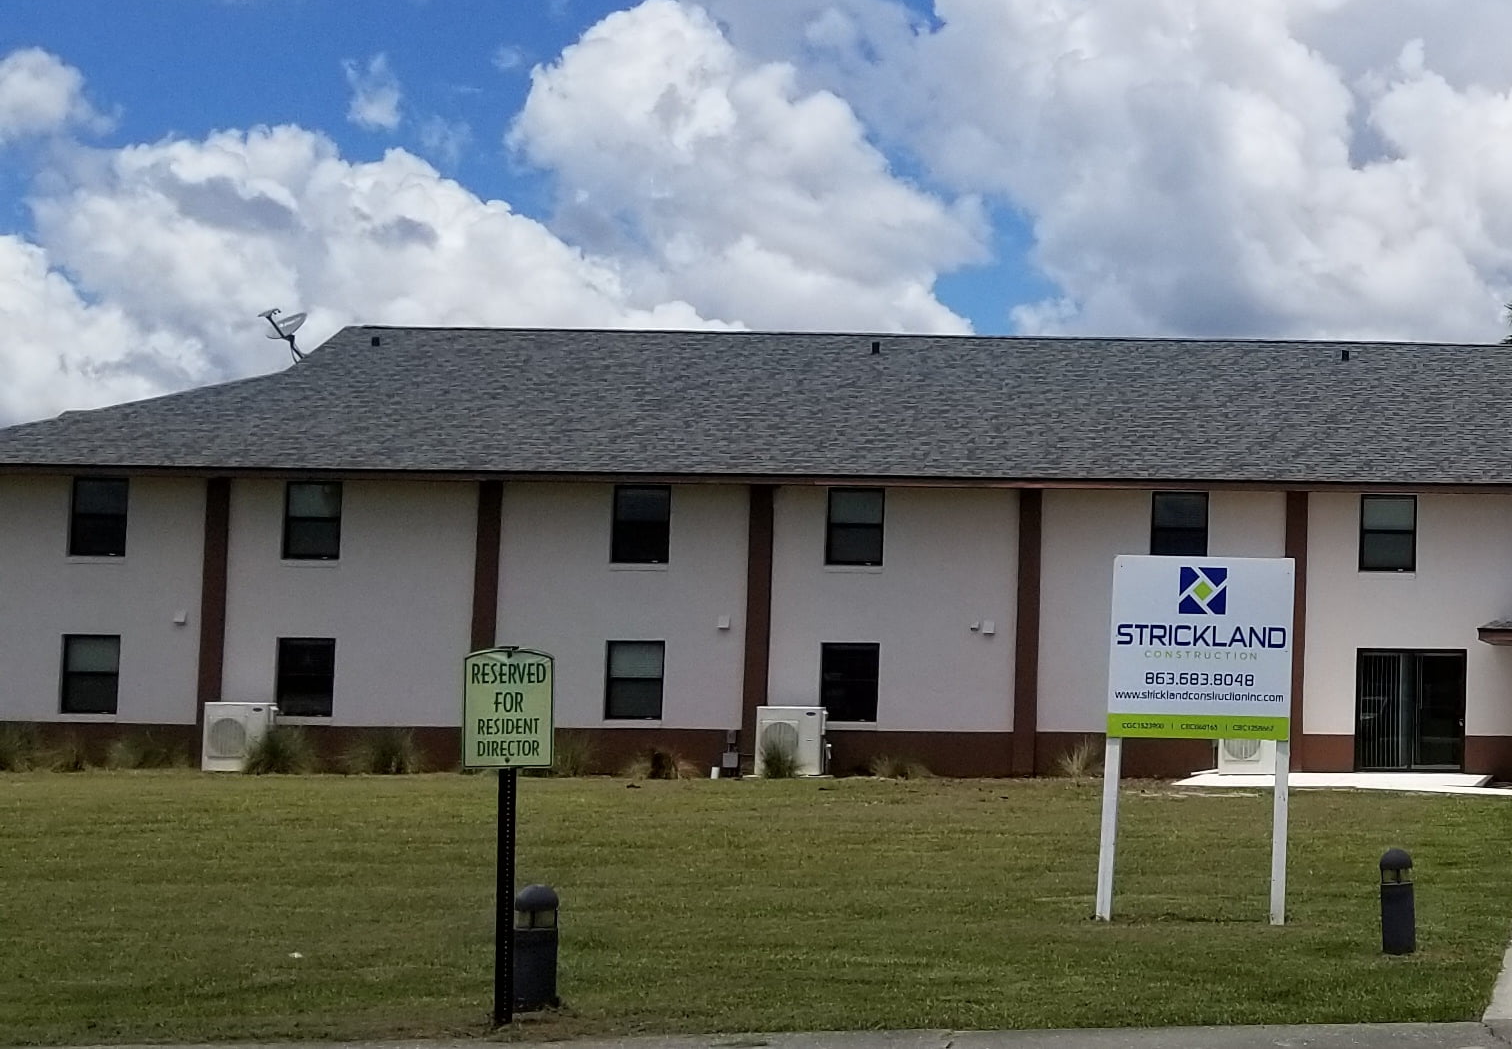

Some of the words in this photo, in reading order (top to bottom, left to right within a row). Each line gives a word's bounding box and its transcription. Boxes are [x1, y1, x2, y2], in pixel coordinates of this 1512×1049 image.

[1116, 624, 1287, 649] STRICKLAND
[1144, 650, 1258, 661] CONSTRUCTION
[471, 662, 547, 685] RESERVED
[1145, 671, 1255, 687] 863.683.8048
[493, 691, 524, 713] FOR
[1115, 689, 1284, 703] www.stricklandconstructioninc.com
[477, 717, 540, 735] RESIDENT
[477, 739, 540, 757] DIRECTOR
